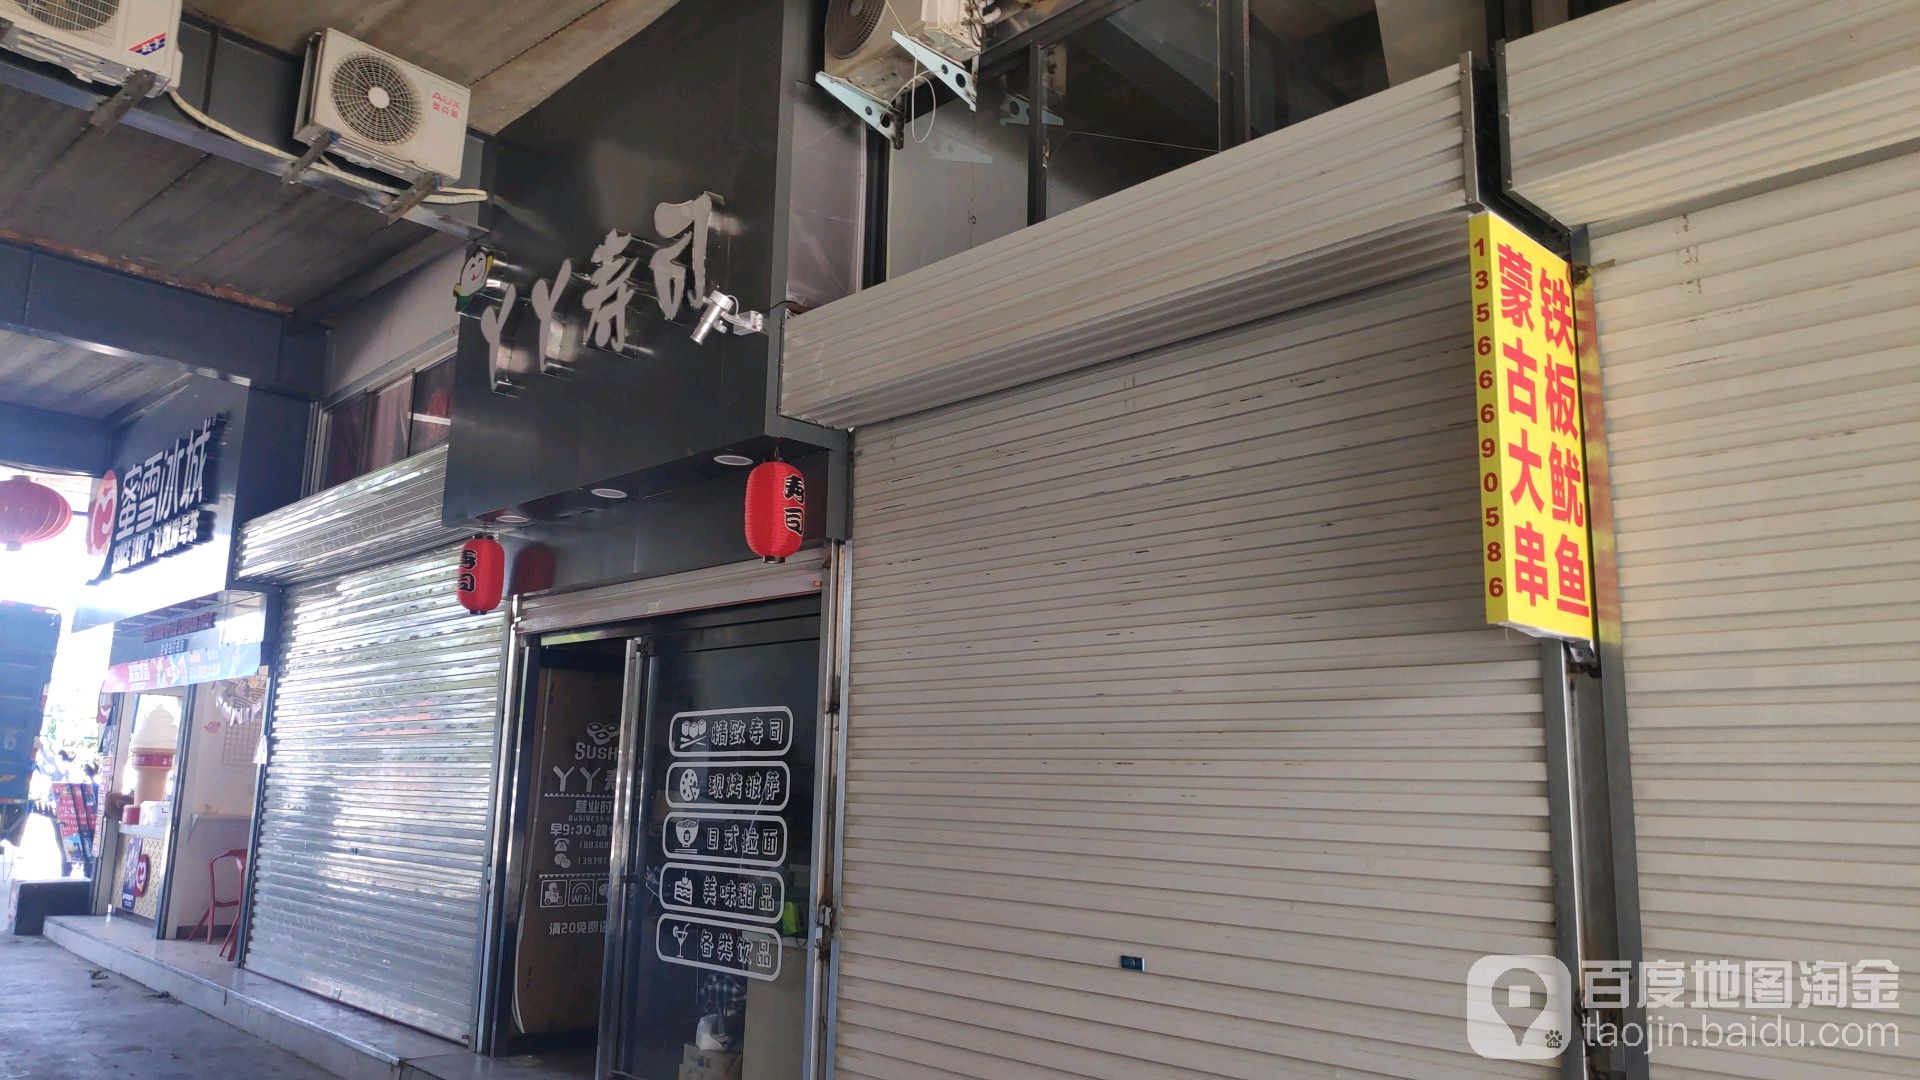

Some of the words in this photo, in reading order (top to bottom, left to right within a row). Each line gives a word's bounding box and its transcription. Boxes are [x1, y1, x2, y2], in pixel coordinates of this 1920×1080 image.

[432, 91, 461, 109] AUX
[1473, 237, 1504, 598] 13566690586
[1497, 242, 1550, 607] 蒙古大串
[1538, 266, 1590, 618] 铁板鱿鱼
[115, 418, 211, 541] 蜜雪冰城
[710, 717, 784, 746] 精致寿司
[707, 770, 781, 801] 现烤披萨
[706, 823, 779, 855] 日式拉面
[703, 874, 776, 912] 美味甜品
[699, 928, 772, 968] 各类饮品
